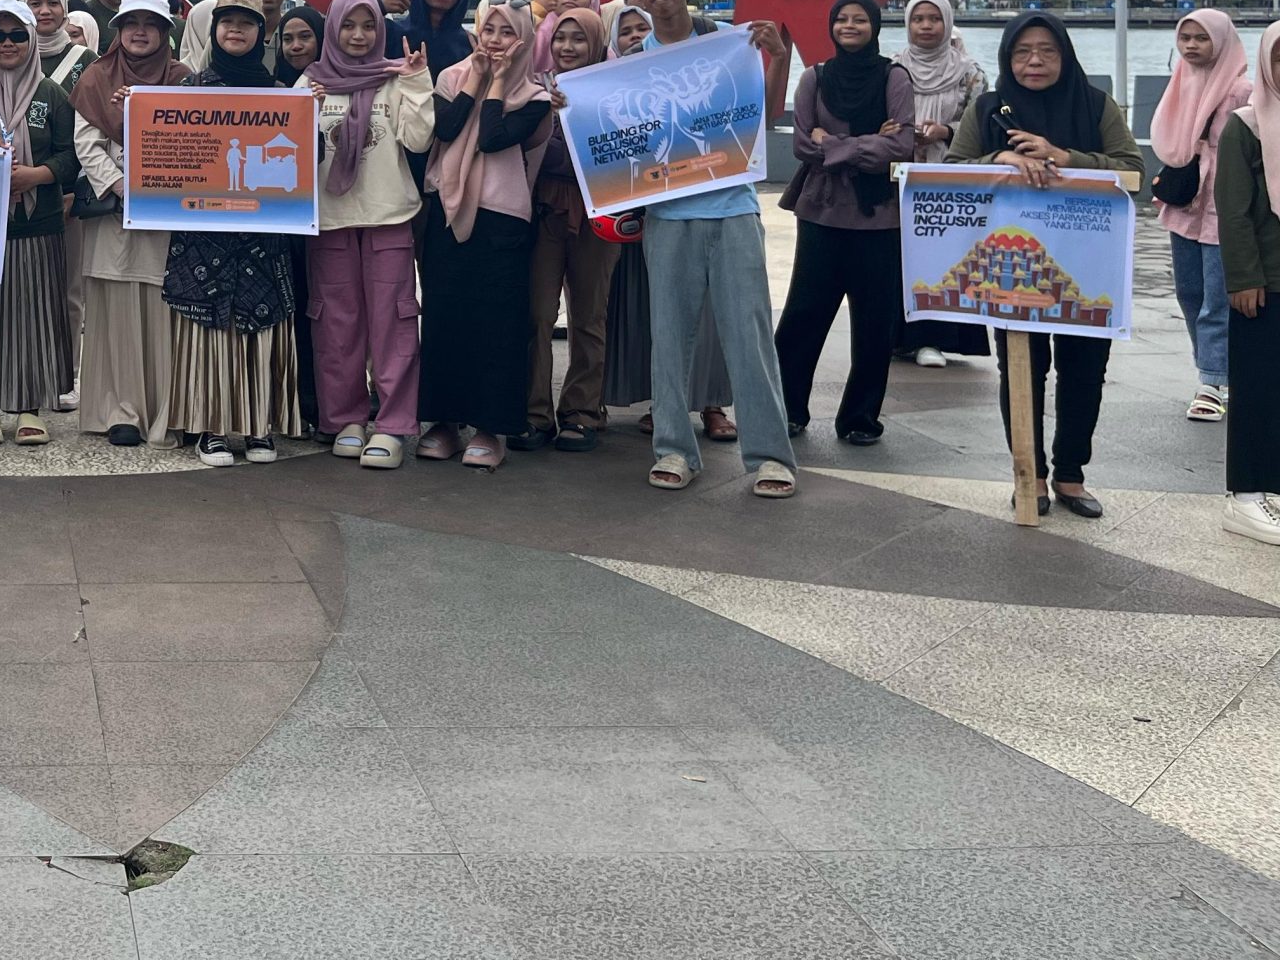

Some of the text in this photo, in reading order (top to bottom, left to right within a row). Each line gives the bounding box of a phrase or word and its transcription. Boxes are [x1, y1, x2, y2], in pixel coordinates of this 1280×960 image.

[153, 109, 290, 127] PENGUMUMAN!
[588, 120, 661, 146] BUILDING FOR
[591, 134, 648, 156] INCLUSION
[594, 144, 651, 166] NETWORK.
[913, 192, 994, 204] MAKASSAR
[1064, 197, 1112, 207] BERSAMA
[913, 204, 976, 215] ROAD TO
[1047, 205, 1111, 216] MEMBANGUN
[914, 215, 987, 227] INCLUSIVE
[1020, 211, 1111, 224] AKSES PARIWISATA
[914, 226, 947, 237] CITY
[1044, 219, 1111, 232] YANG SETARA
